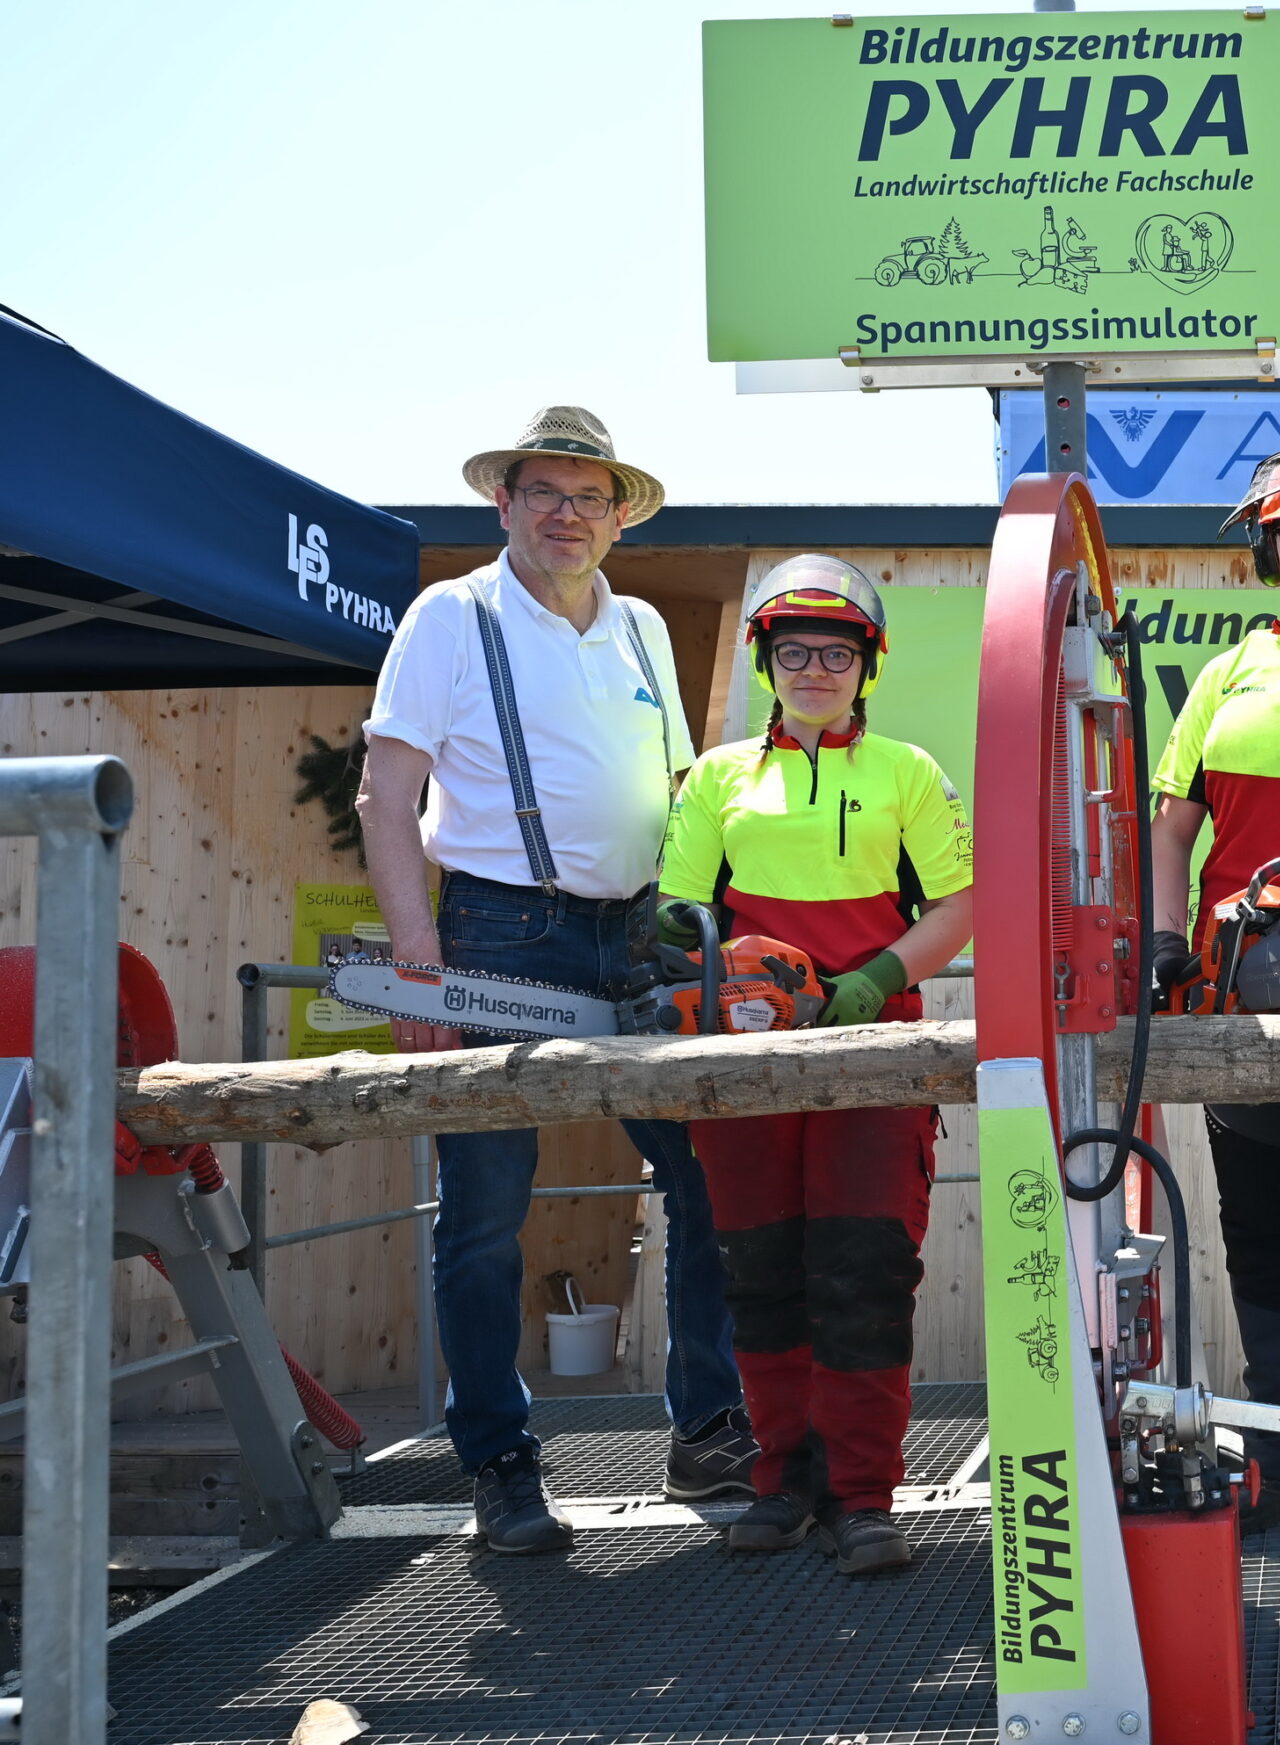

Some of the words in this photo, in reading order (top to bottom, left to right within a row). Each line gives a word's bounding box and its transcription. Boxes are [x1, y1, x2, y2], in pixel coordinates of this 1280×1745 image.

[859, 26, 1243, 73] Bildungszentrum
[858, 74, 1249, 162] PYHRA
[854, 170, 1109, 200] Landwirtschaftliche
[1116, 168, 1254, 194] Fachschule
[856, 307, 1258, 352] Spannungssimulator
[325, 581, 397, 637] PYHRA
[469, 991, 577, 1026] Husqvarna
[997, 1454, 1025, 1665] Bildungszentrum
[1021, 1449, 1077, 1663] PYHRA
